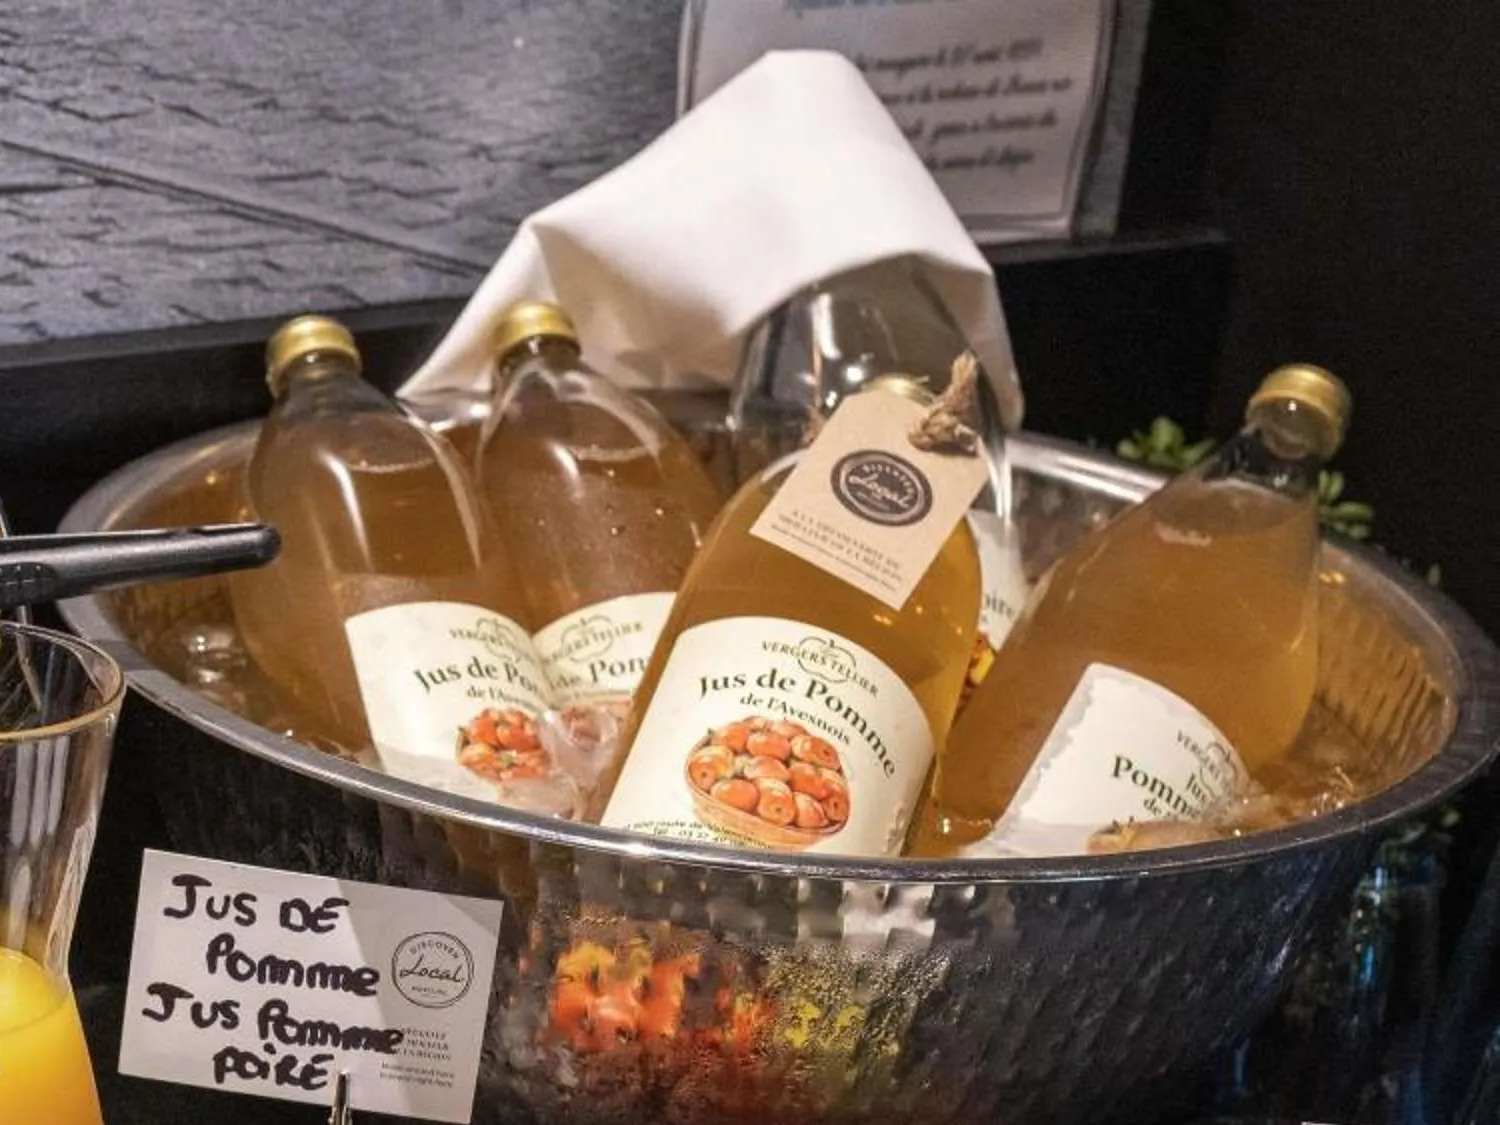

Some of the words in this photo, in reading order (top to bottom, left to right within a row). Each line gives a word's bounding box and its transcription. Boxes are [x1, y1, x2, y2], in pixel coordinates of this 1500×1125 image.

[413, 663, 462, 695] Jus
[467, 654, 499, 679] de
[589, 657, 646, 683] Pom
[761, 640, 828, 666] VERGERS
[830, 659, 879, 697] TELLIER
[700, 671, 747, 698] Jus
[756, 667, 797, 693] de
[804, 679, 897, 778] Pomme
[740, 692, 764, 707] de
[766, 698, 851, 745] l'Avesnois
[279, 897, 350, 933] DE
[399, 952, 465, 983] Local
